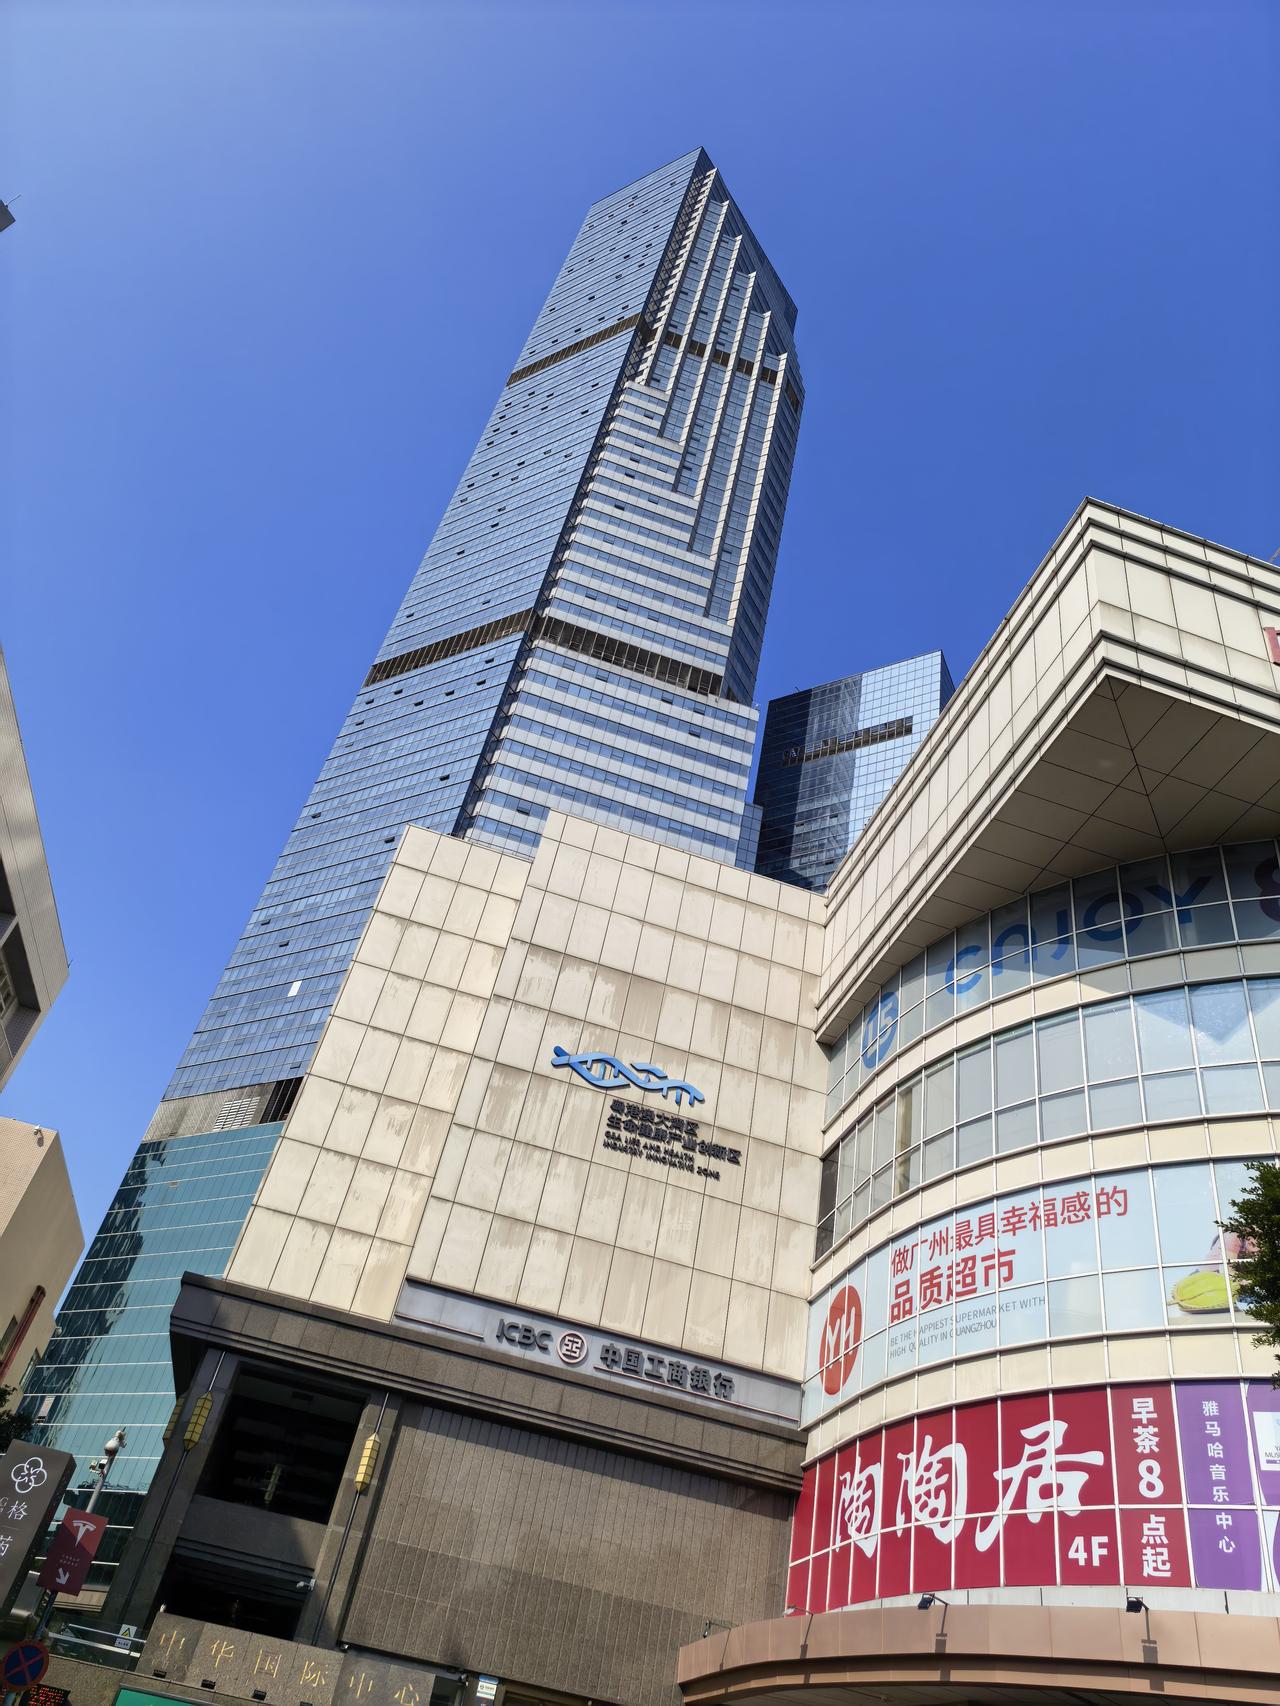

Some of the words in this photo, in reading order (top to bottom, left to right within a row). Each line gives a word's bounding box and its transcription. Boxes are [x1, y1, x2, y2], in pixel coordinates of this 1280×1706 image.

[603, 1139, 643, 1158] INDUSTRY
[697, 1166, 720, 1181] ZONE
[606, 1113, 743, 1166] 生命健康产业创新区
[642, 1142, 661, 1154] AND
[663, 1147, 695, 1164] HEALTH
[891, 1185, 1128, 1278] 做广州最具幸福感的
[890, 1249, 1016, 1324] 品质超市
[496, 1319, 553, 1351] ICBC
[890, 1336, 899, 1347] BE
[900, 1330, 913, 1343] THE
[950, 1301, 1017, 1325] SUPERMARKET
[1019, 1296, 1046, 1310] WITH
[890, 1345, 907, 1360] HIGH
[940, 1330, 948, 1341] IN
[950, 1319, 998, 1338] GUANGZHOU
[600, 1343, 735, 1400] 中国工商银行
[836, 1419, 1104, 1558] 陶陶居
[1131, 1397, 1172, 1578] 早茶8点起
[1202, 1401, 1236, 1554] 雅马哈音乐中心
[1068, 1536, 1109, 1567] 4F
[160, 1631, 419, 1706] 中华国际中心
